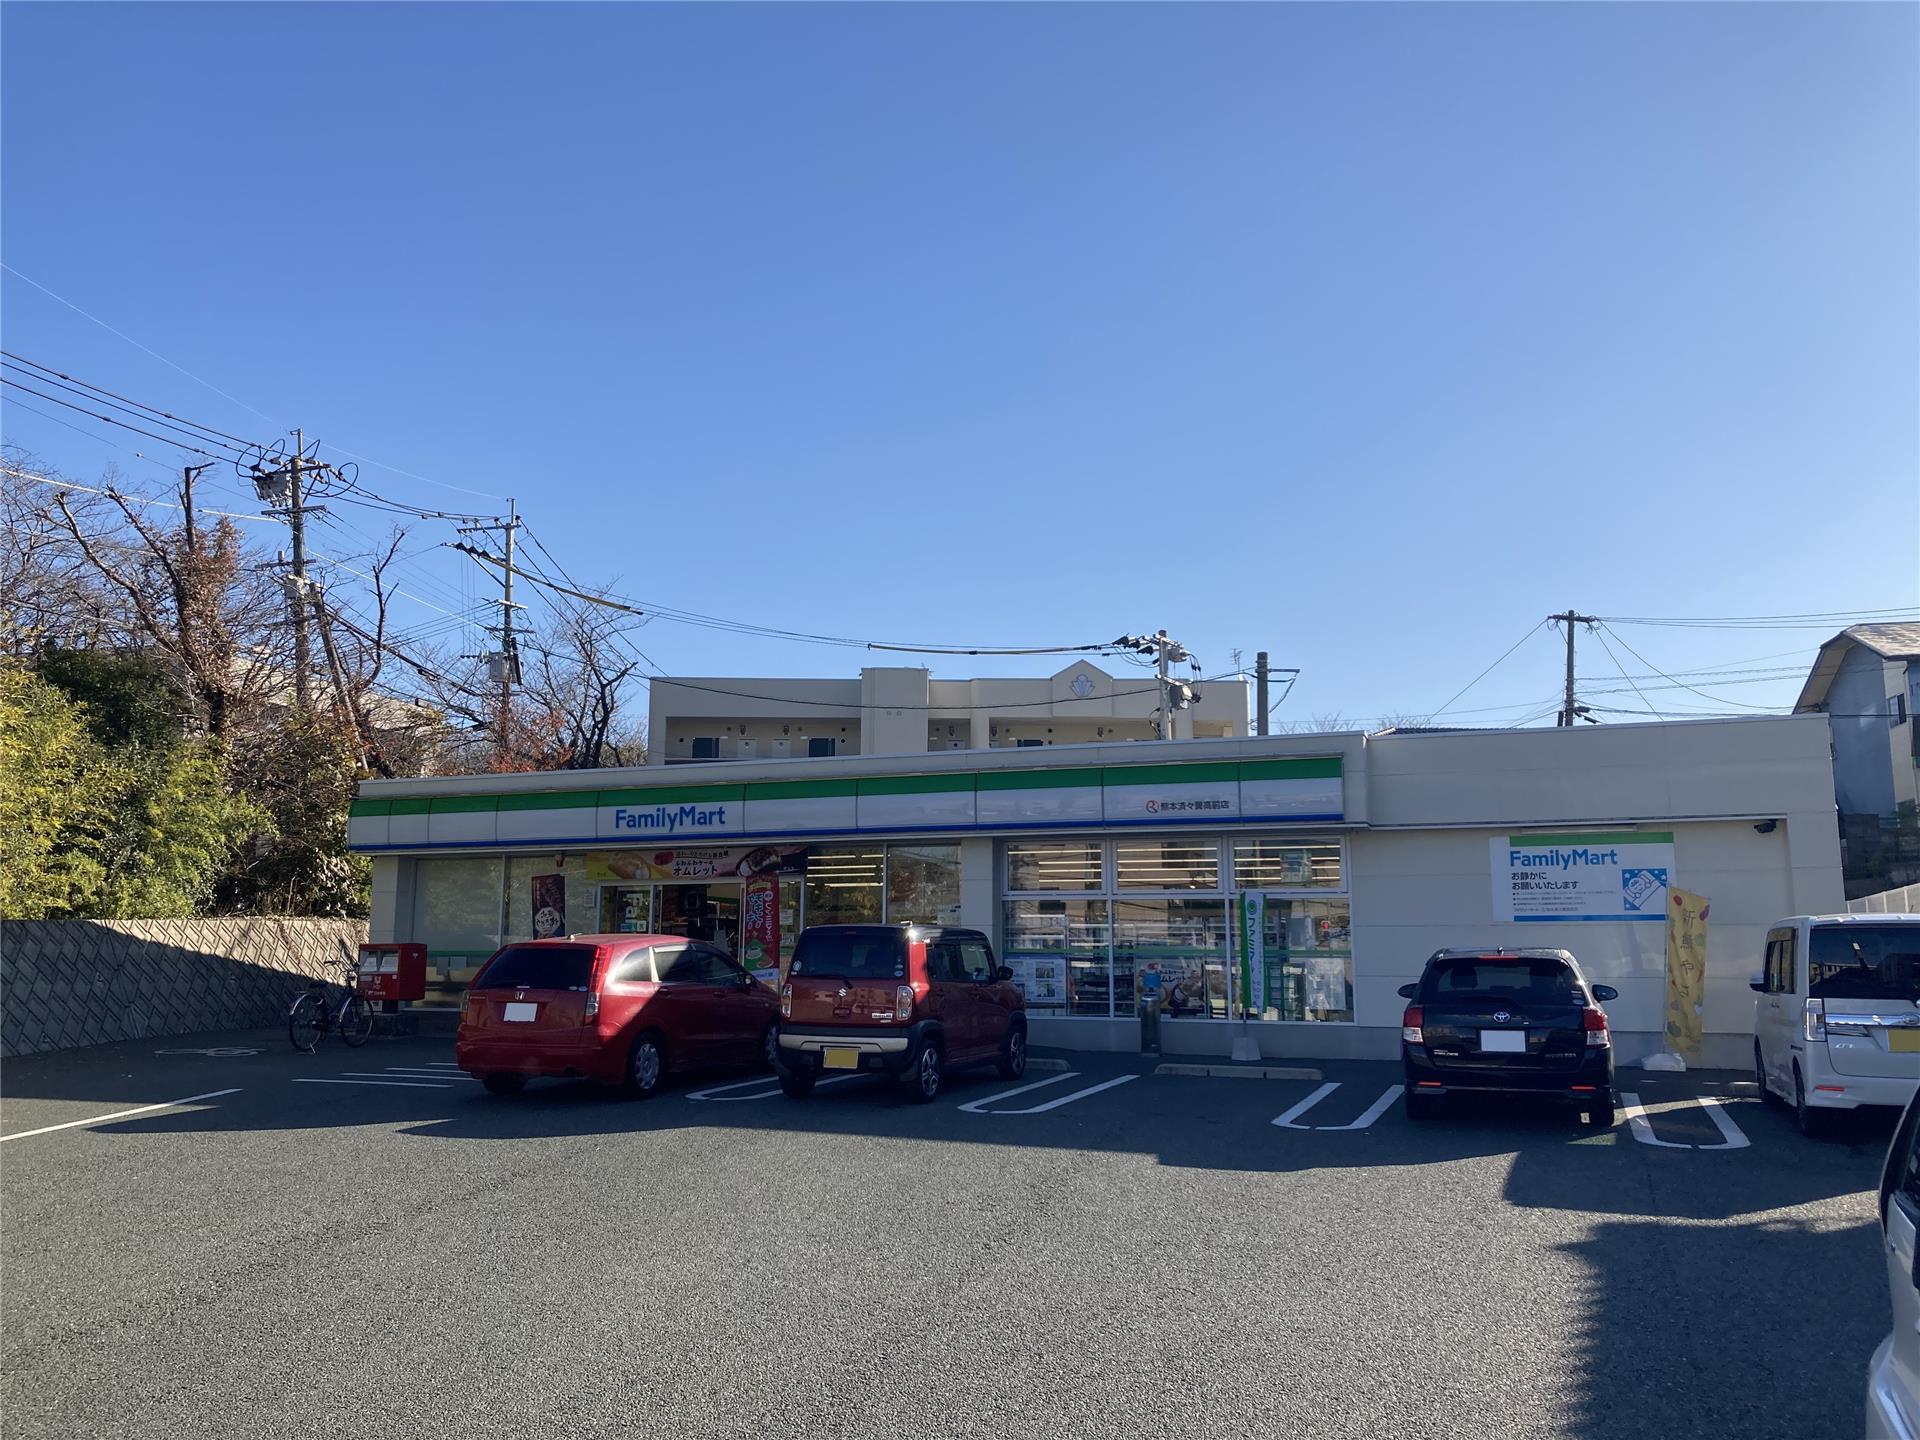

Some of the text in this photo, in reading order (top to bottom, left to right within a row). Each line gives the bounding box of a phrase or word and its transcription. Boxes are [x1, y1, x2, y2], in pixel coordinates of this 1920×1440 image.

[616, 806, 725, 832] FamilyMart
[1510, 849, 1618, 870] FamilyMart
[673, 865, 718, 876] オムレット
[1512, 872, 1547, 881] お静かに
[1512, 881, 1579, 890] お願いいたします
